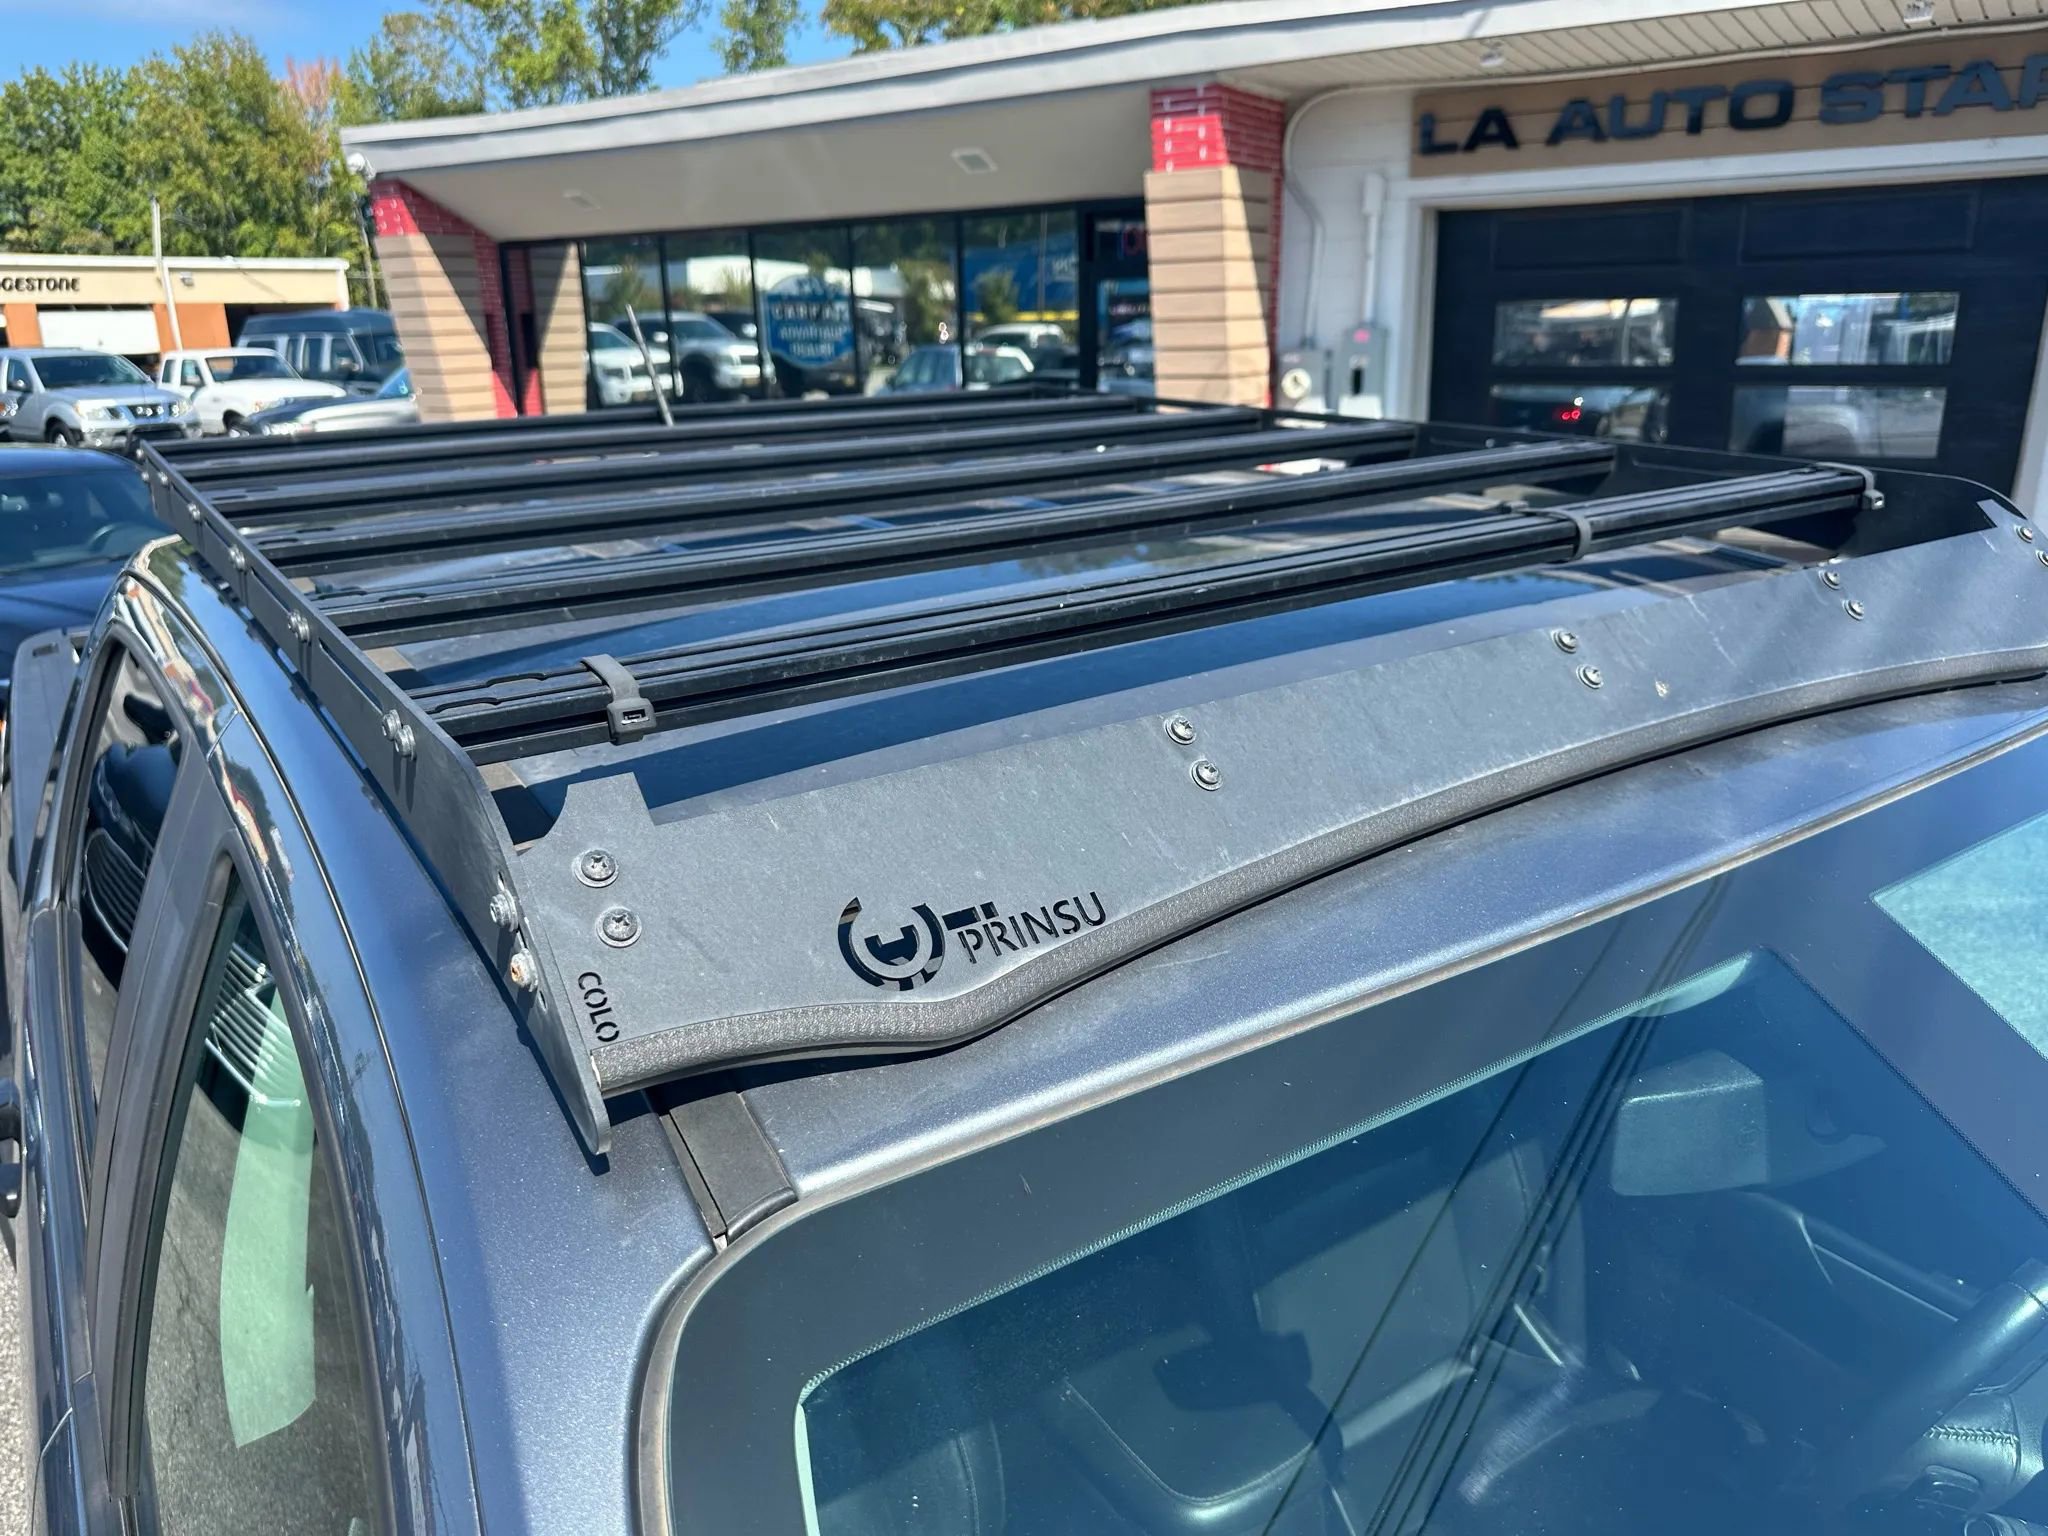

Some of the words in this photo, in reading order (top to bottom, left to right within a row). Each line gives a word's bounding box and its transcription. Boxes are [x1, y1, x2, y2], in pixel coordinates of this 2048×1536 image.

[1418, 107, 1519, 156] LA
[1545, 79, 1795, 147] AUTO
[0, 277, 80, 292] GESTONE
[957, 891, 1107, 964] PRINSU
[578, 972, 619, 1042] COLO
